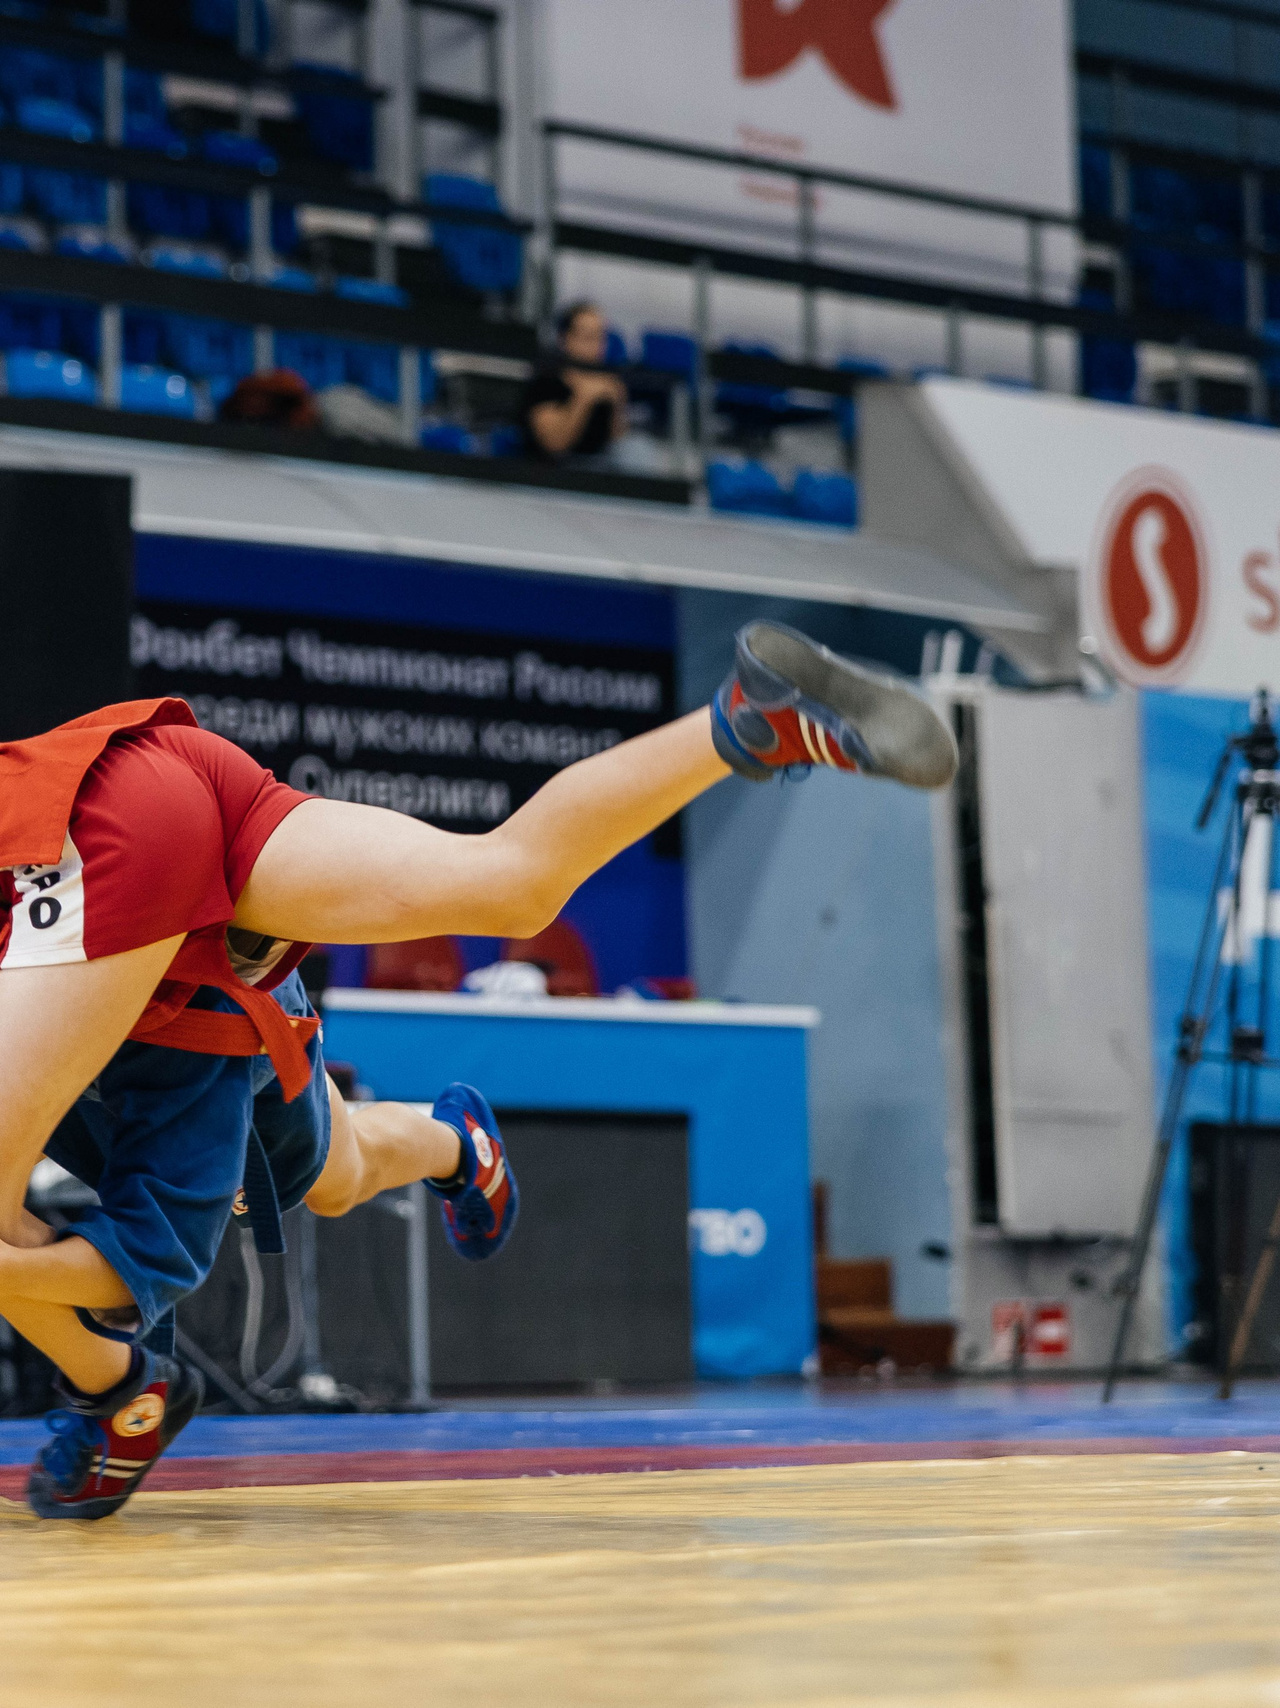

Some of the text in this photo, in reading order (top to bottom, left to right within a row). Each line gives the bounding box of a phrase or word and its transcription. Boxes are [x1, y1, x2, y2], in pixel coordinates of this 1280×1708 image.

[286, 629, 508, 698] Чемпионат
[515, 651, 661, 712] России
[172, 692, 299, 748] реди
